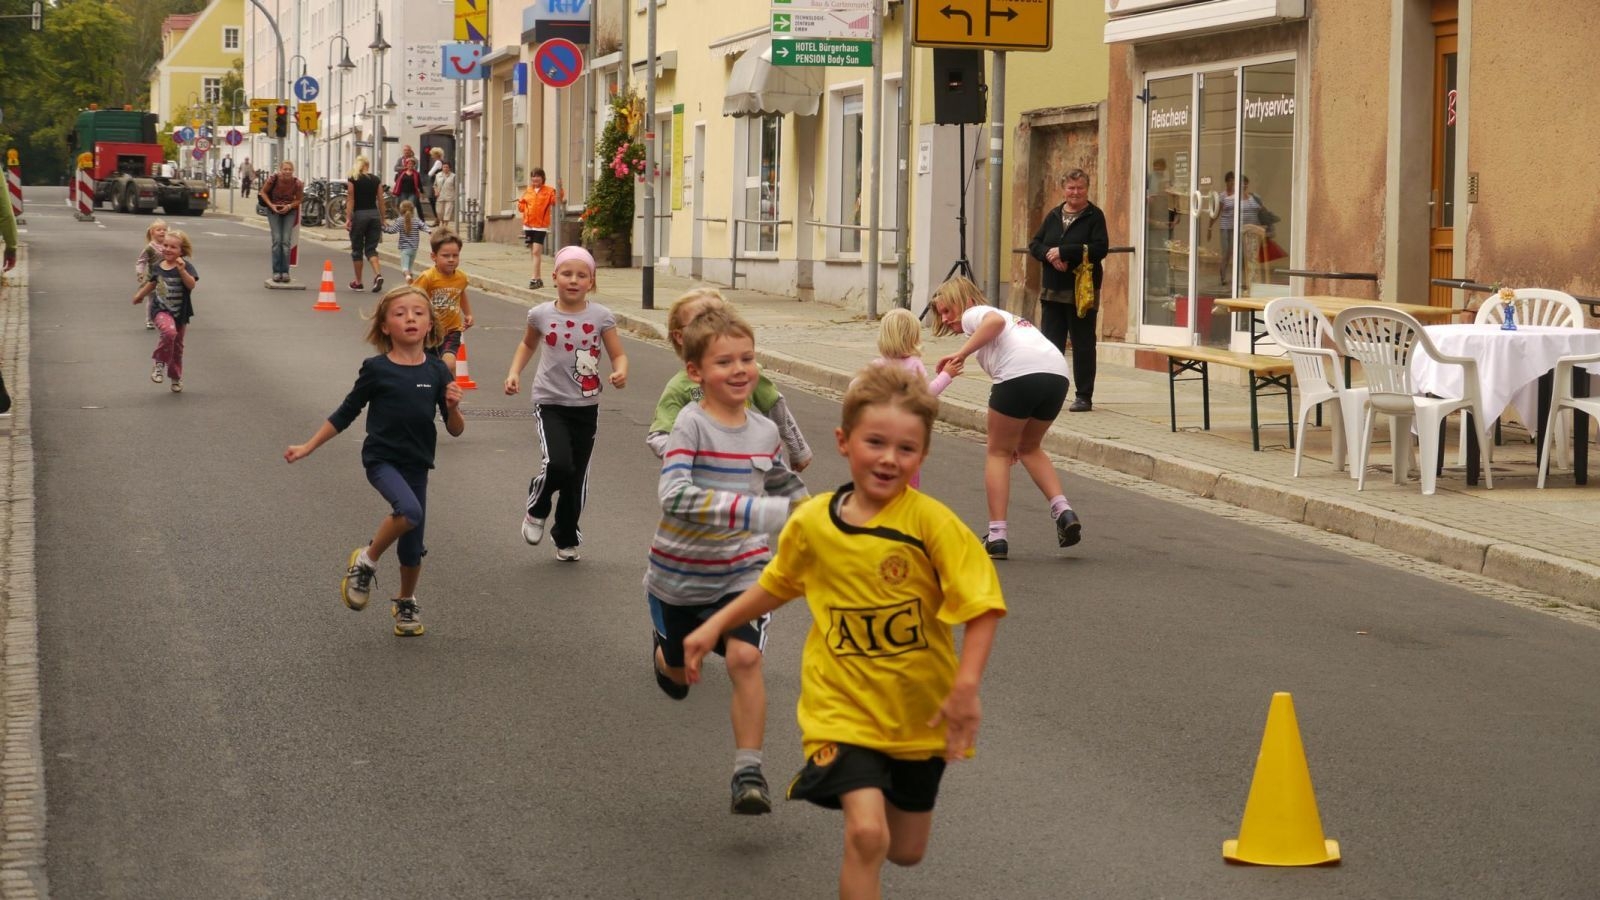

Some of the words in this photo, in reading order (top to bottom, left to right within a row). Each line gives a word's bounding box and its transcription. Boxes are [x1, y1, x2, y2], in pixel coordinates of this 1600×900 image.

[796, 42, 817, 52] HOTEL
[819, 43, 859, 54] Bürgerhaus
[796, 55, 826, 64] PENSION
[828, 55, 845, 66] Body
[846, 56, 859, 64] Sun
[1151, 105, 1189, 129] Fleischerei
[1244, 94, 1294, 122] Partyservice
[834, 608, 918, 651] AIG
